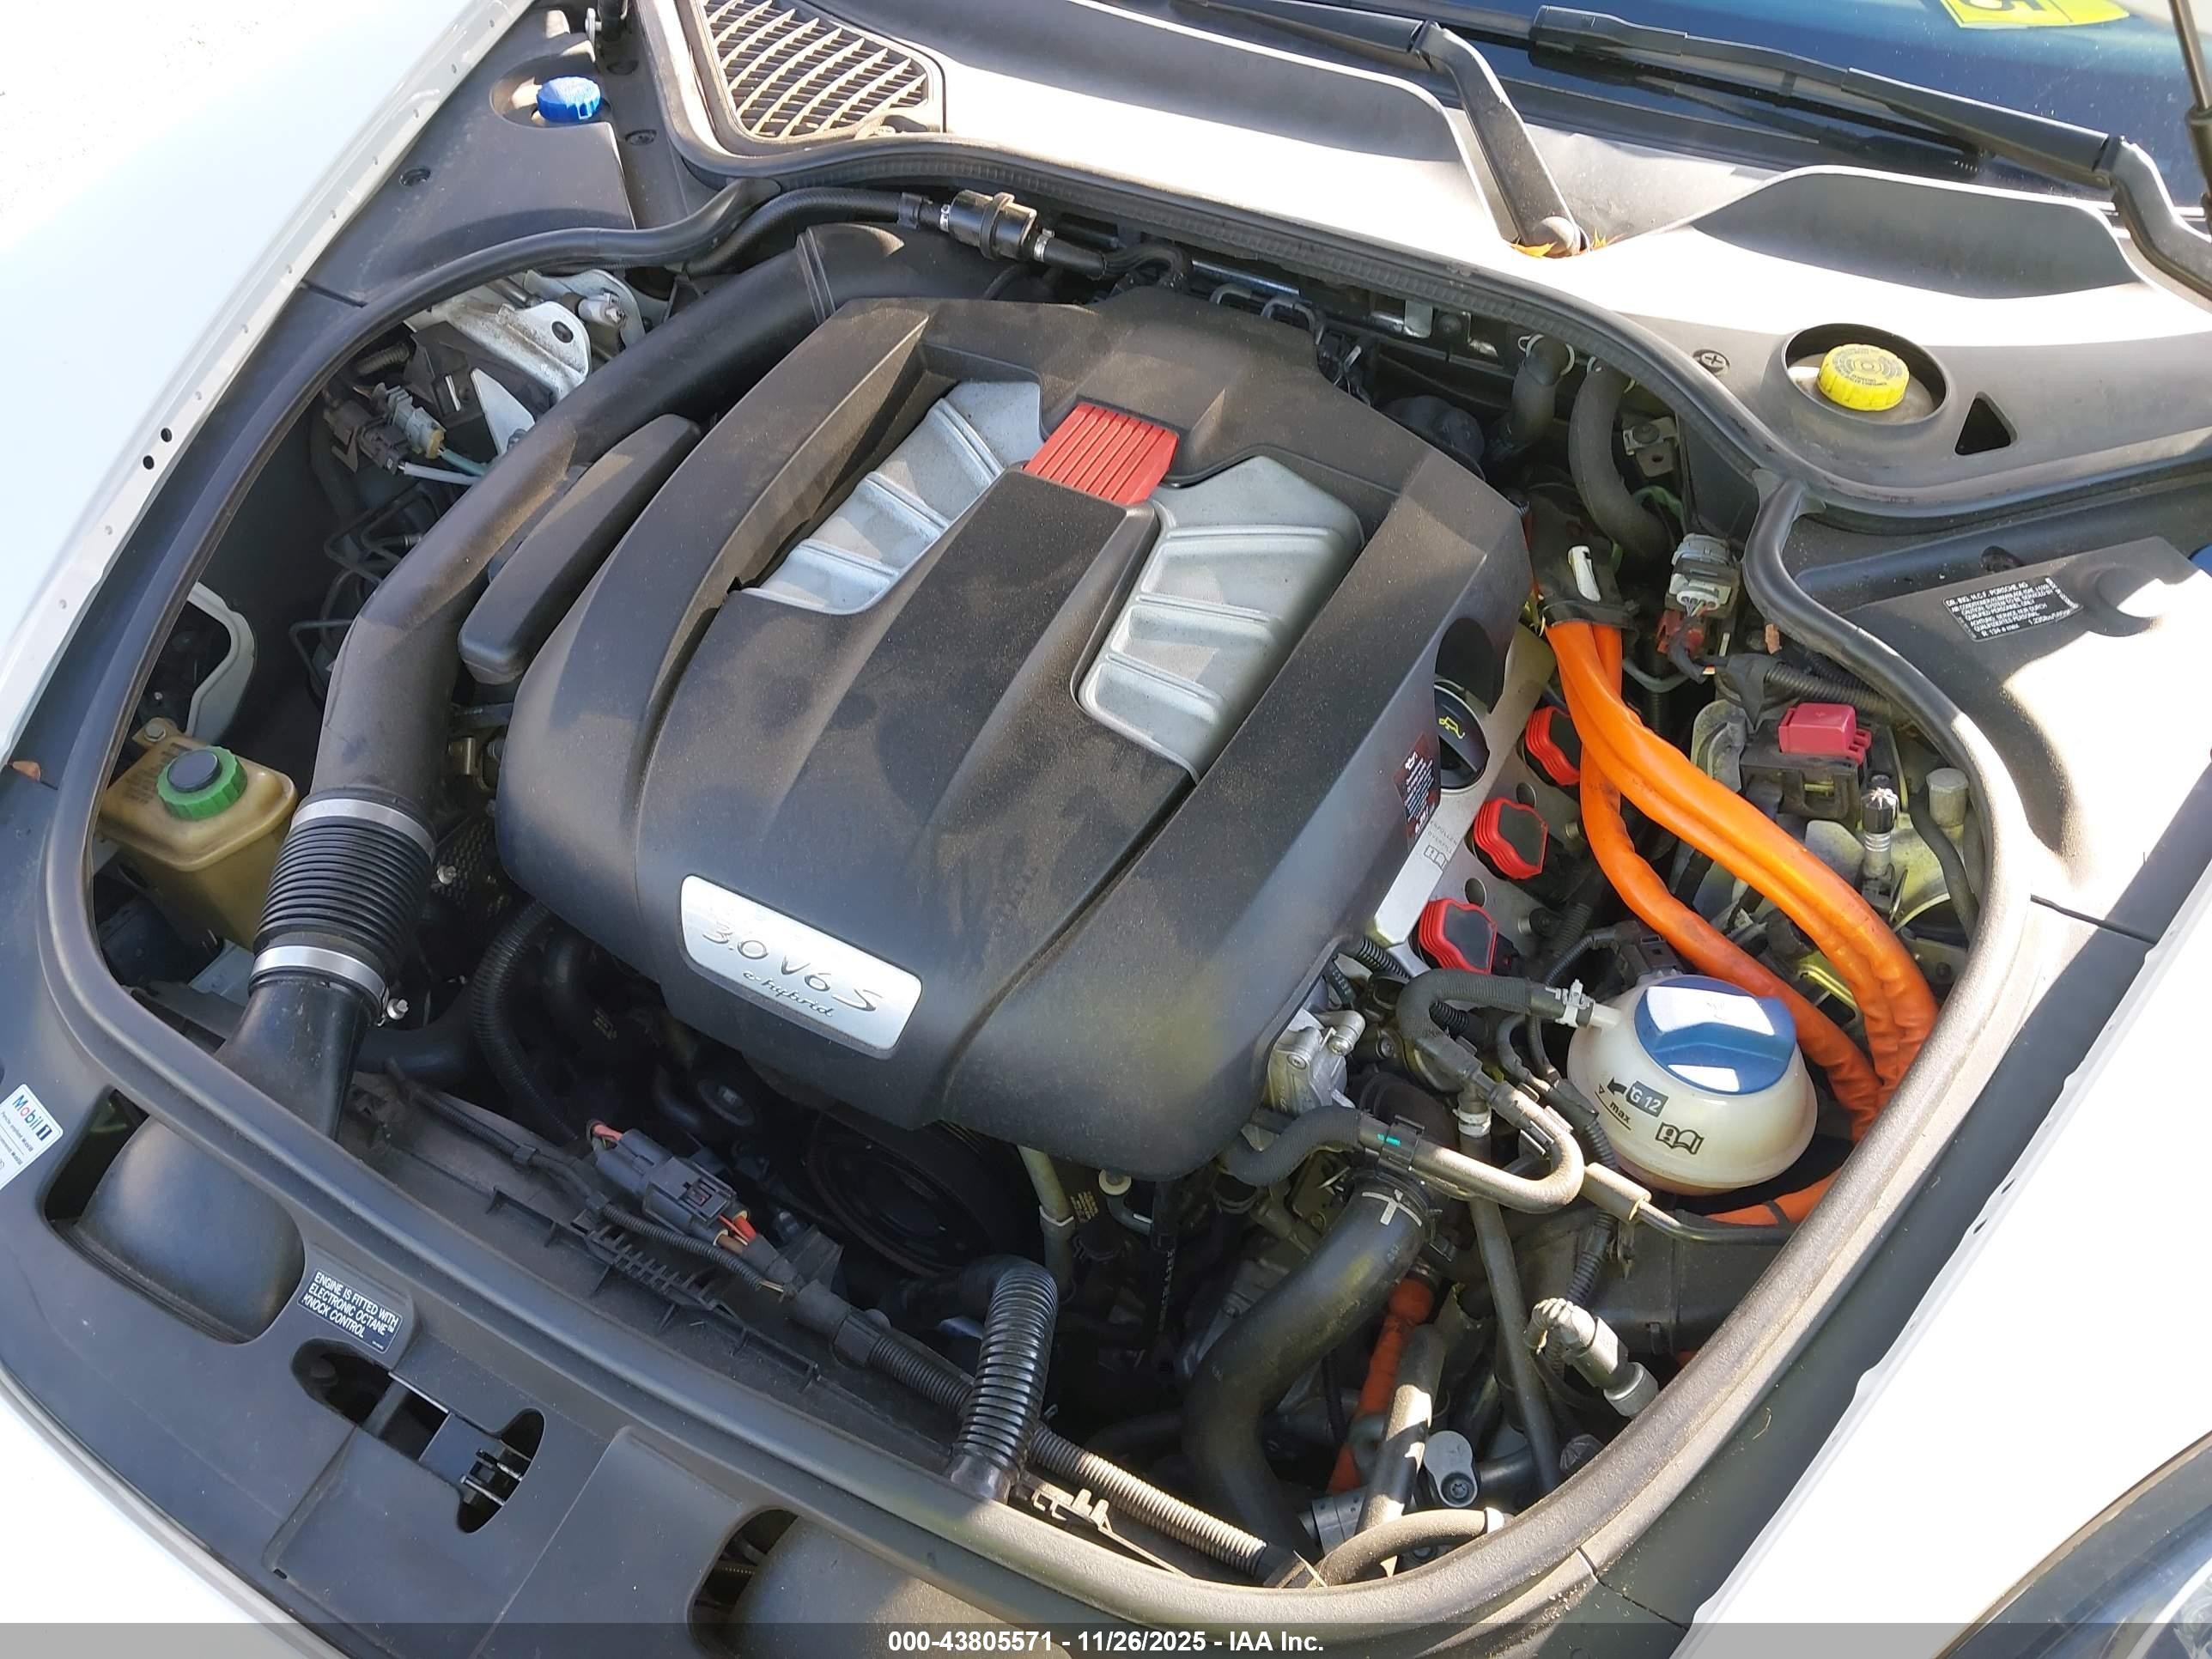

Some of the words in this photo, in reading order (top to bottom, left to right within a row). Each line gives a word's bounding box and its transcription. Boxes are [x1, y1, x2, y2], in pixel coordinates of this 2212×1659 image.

[702, 921, 769, 960] 3.0
[780, 954, 832, 992] V6
[830, 988, 884, 1012] S
[12, 1094, 45, 1131] Mobil
[35, 1123, 53, 1142] 1
[1609, 1100, 1632, 1124] max
[1630, 1086, 1644, 1104] G
[1644, 1096, 1662, 1114] 12
[301, 1292, 332, 1318] KNOCK
[328, 1309, 367, 1339] CONTROL
[308, 1282, 357, 1318] ELECTRONIC
[314, 1271, 344, 1297] ENGINE
[342, 1287, 353, 1302] IS
[350, 1292, 379, 1316] FITTED
[378, 1307, 399, 1328] WITH
